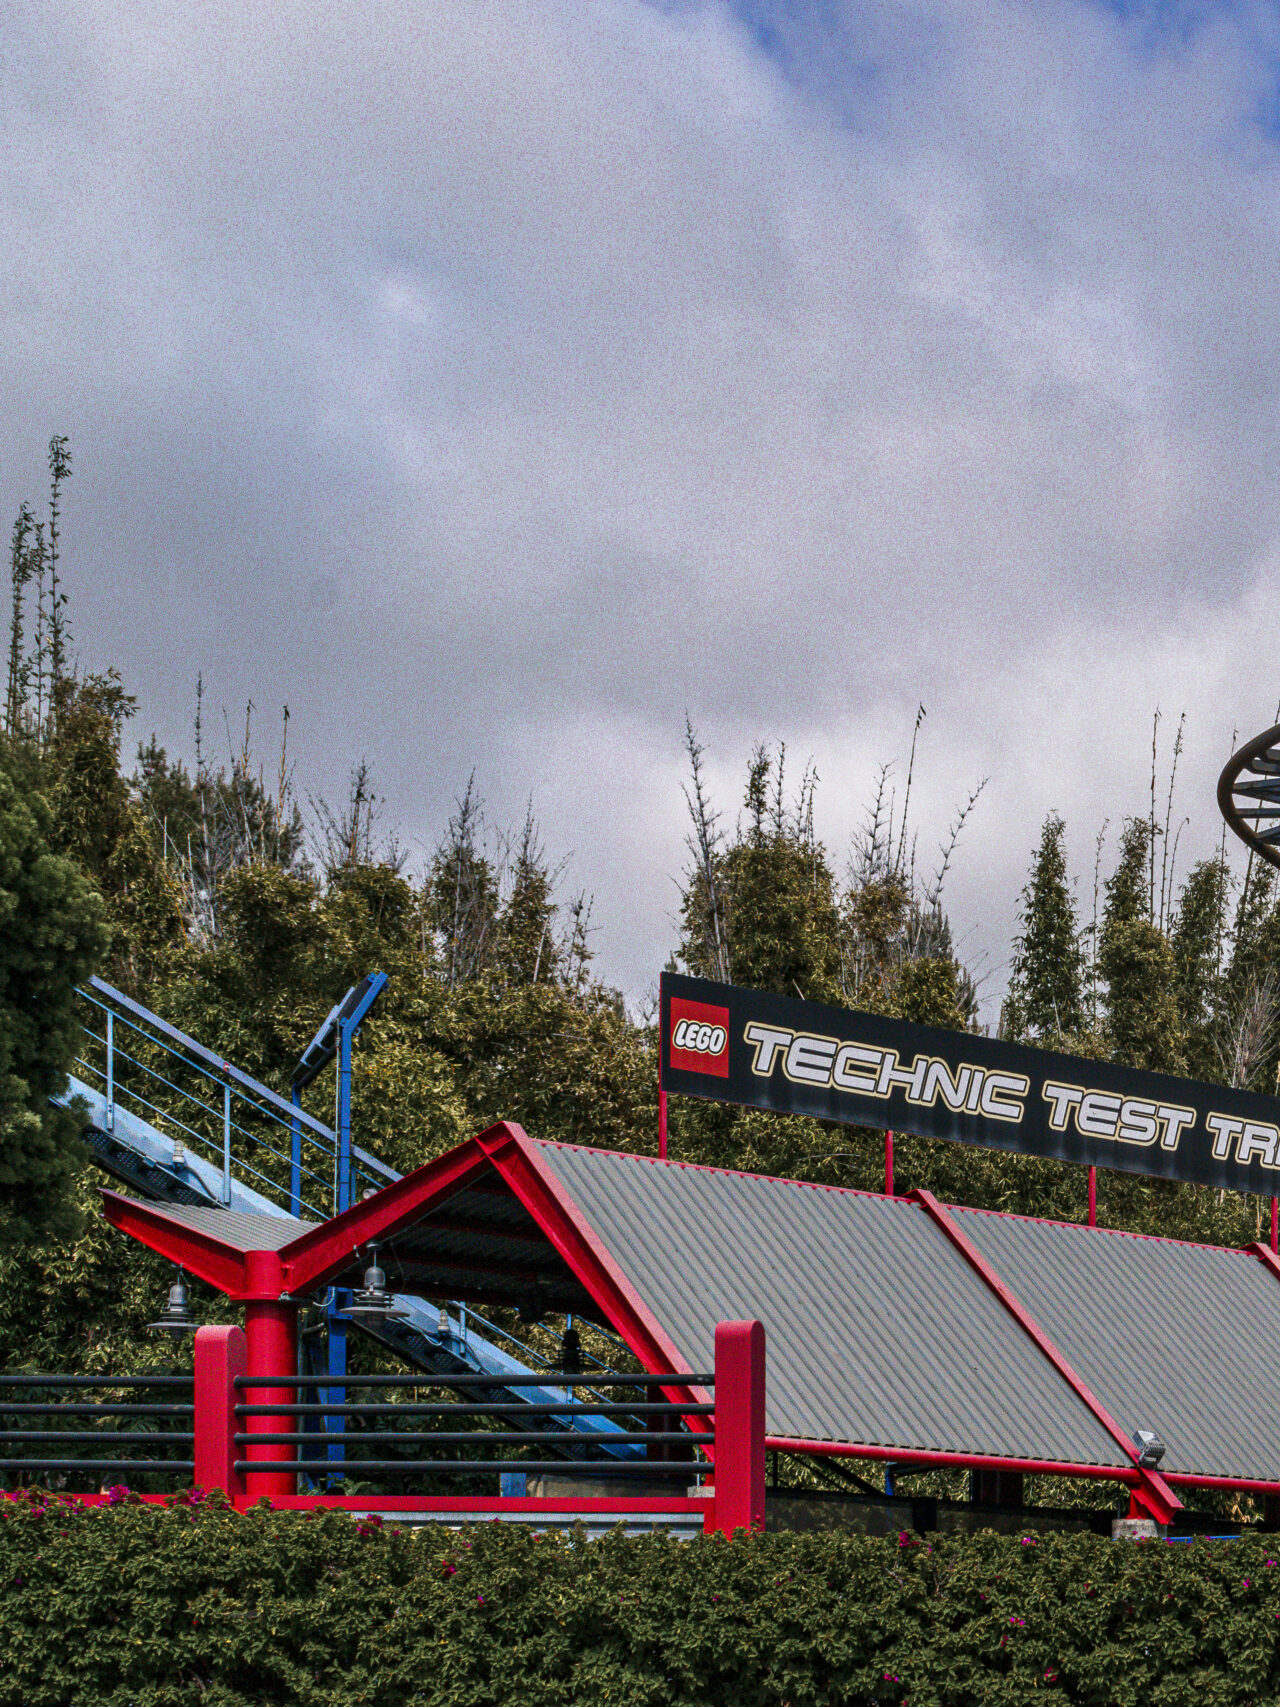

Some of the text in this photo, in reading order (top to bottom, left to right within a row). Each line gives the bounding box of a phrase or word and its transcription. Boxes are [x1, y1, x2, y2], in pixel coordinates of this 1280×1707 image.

[674, 1020, 726, 1054] LEGO
[745, 1023, 1029, 1121] TECHNIC
[1043, 1081, 1196, 1149] TEST
